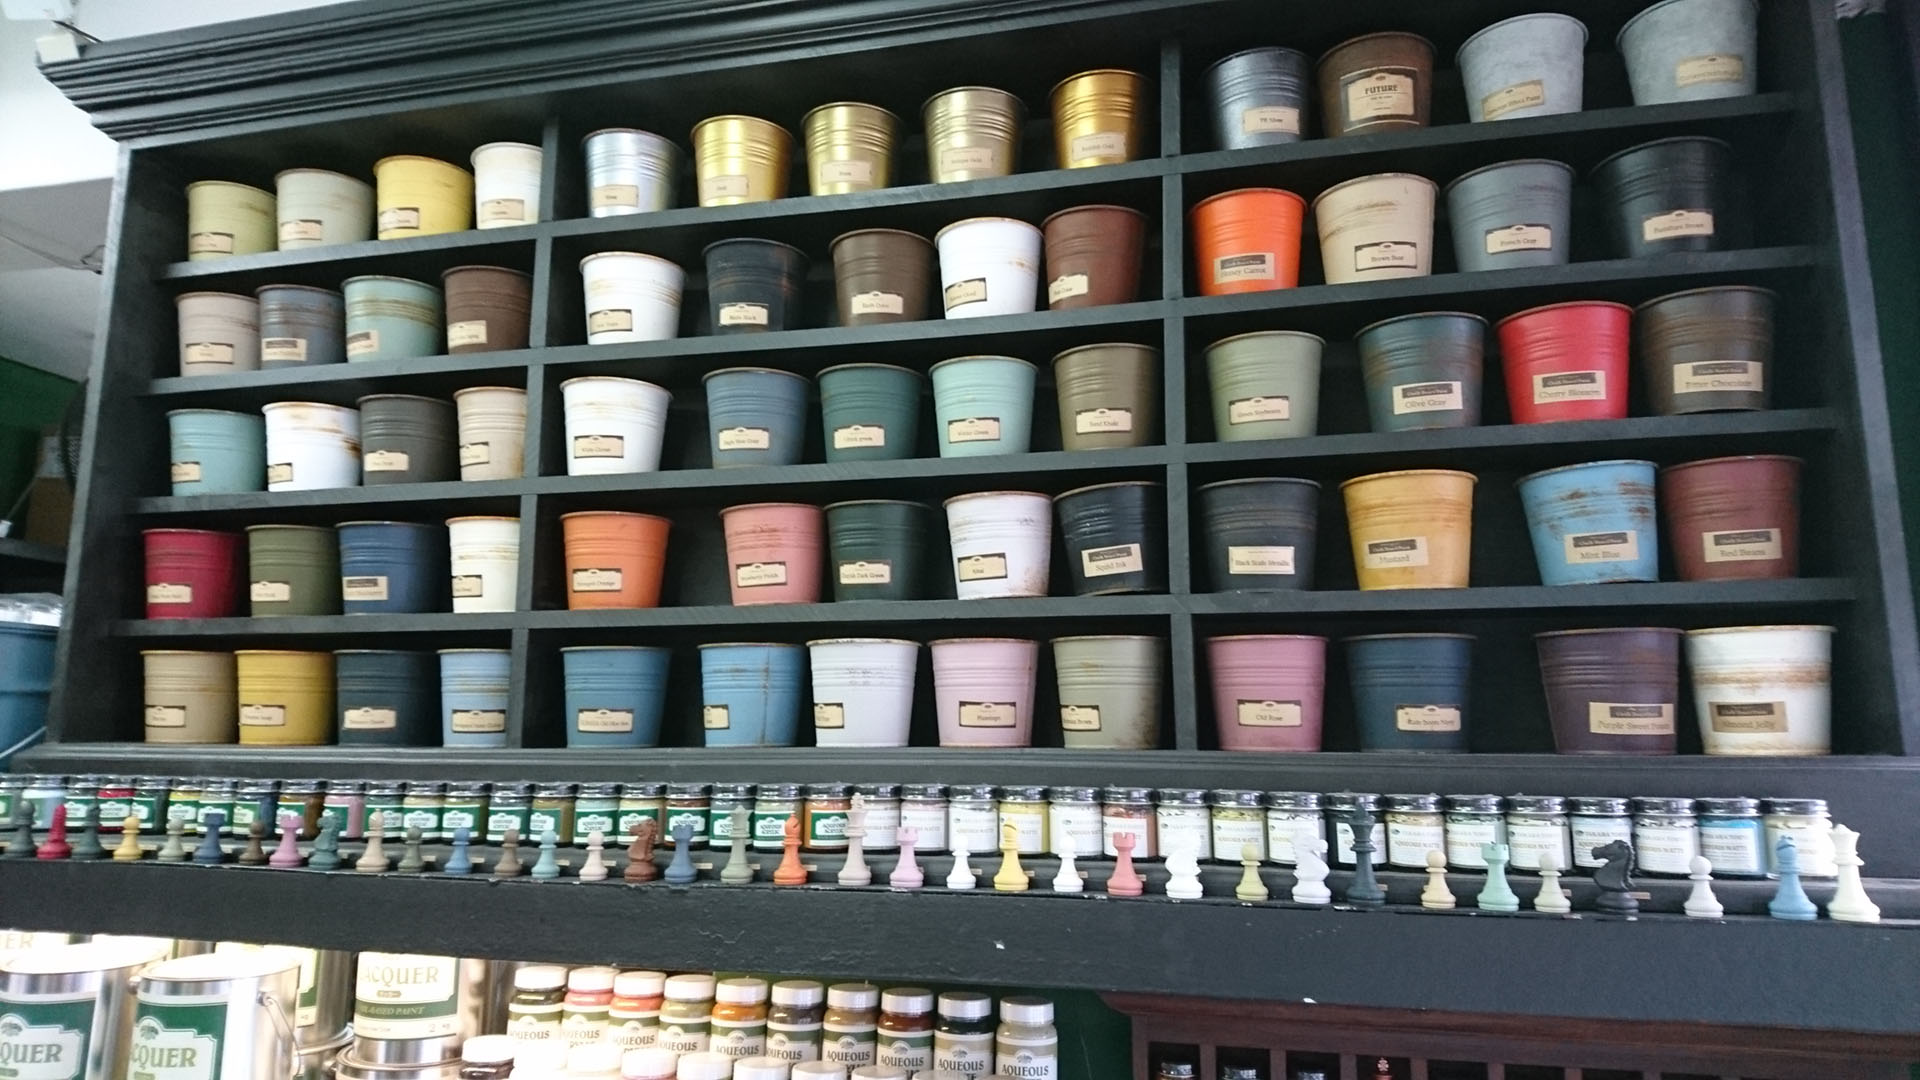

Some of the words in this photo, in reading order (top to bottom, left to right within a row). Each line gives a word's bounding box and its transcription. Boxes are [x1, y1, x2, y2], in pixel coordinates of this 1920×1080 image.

[1364, 84, 1398, 96] FUTURE
[1404, 400, 1426, 409] Olive
[826, 1049, 871, 1062] AQUEOUS
[880, 1055, 924, 1067] AQUEOUS
[939, 1058, 985, 1070] AQUEOUS
[1002, 1063, 1049, 1076] AQUEOUS
